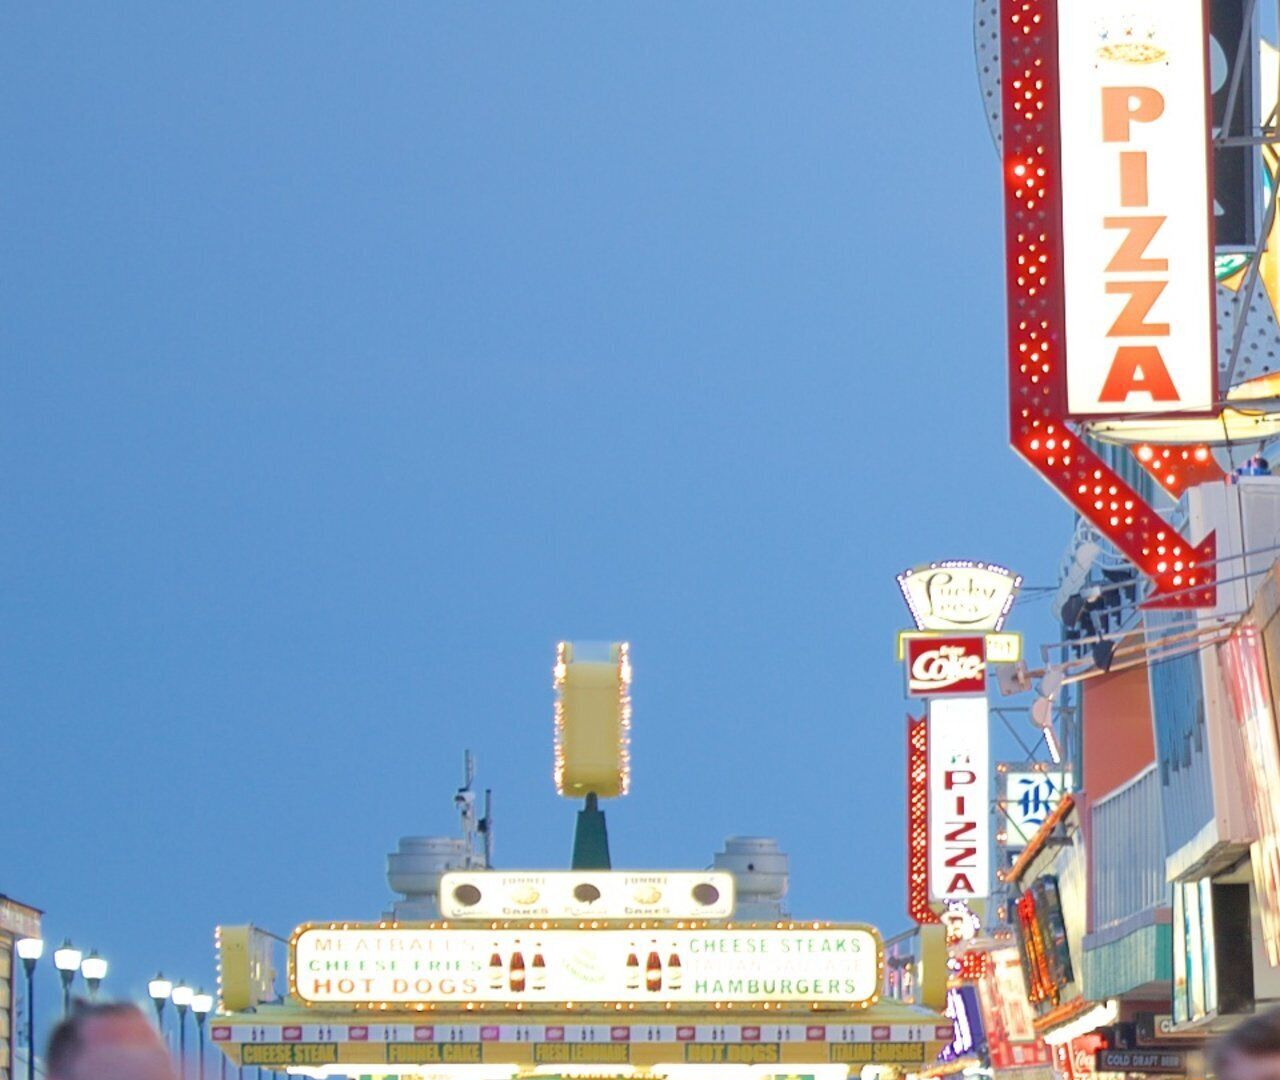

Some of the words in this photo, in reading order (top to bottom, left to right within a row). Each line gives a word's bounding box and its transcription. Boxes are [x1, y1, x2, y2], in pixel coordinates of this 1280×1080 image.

[1098, 86, 1181, 402] PIZZA
[912, 650, 984, 681] Coke
[943, 770, 977, 894] PIZZA
[689, 938, 769, 953] CHEESE
[780, 938, 862, 953] STEAKS
[308, 960, 397, 972] CHEESE
[414, 960, 482, 972] FRIES
[313, 978, 376, 995] HOT
[392, 978, 478, 995] DOGS
[694, 978, 857, 995] HAMBURGERS
[244, 1044, 292, 1063] CHEESE
[1107, 1056, 1131, 1066] COLD
[1132, 1056, 1159, 1066] DRAFT
